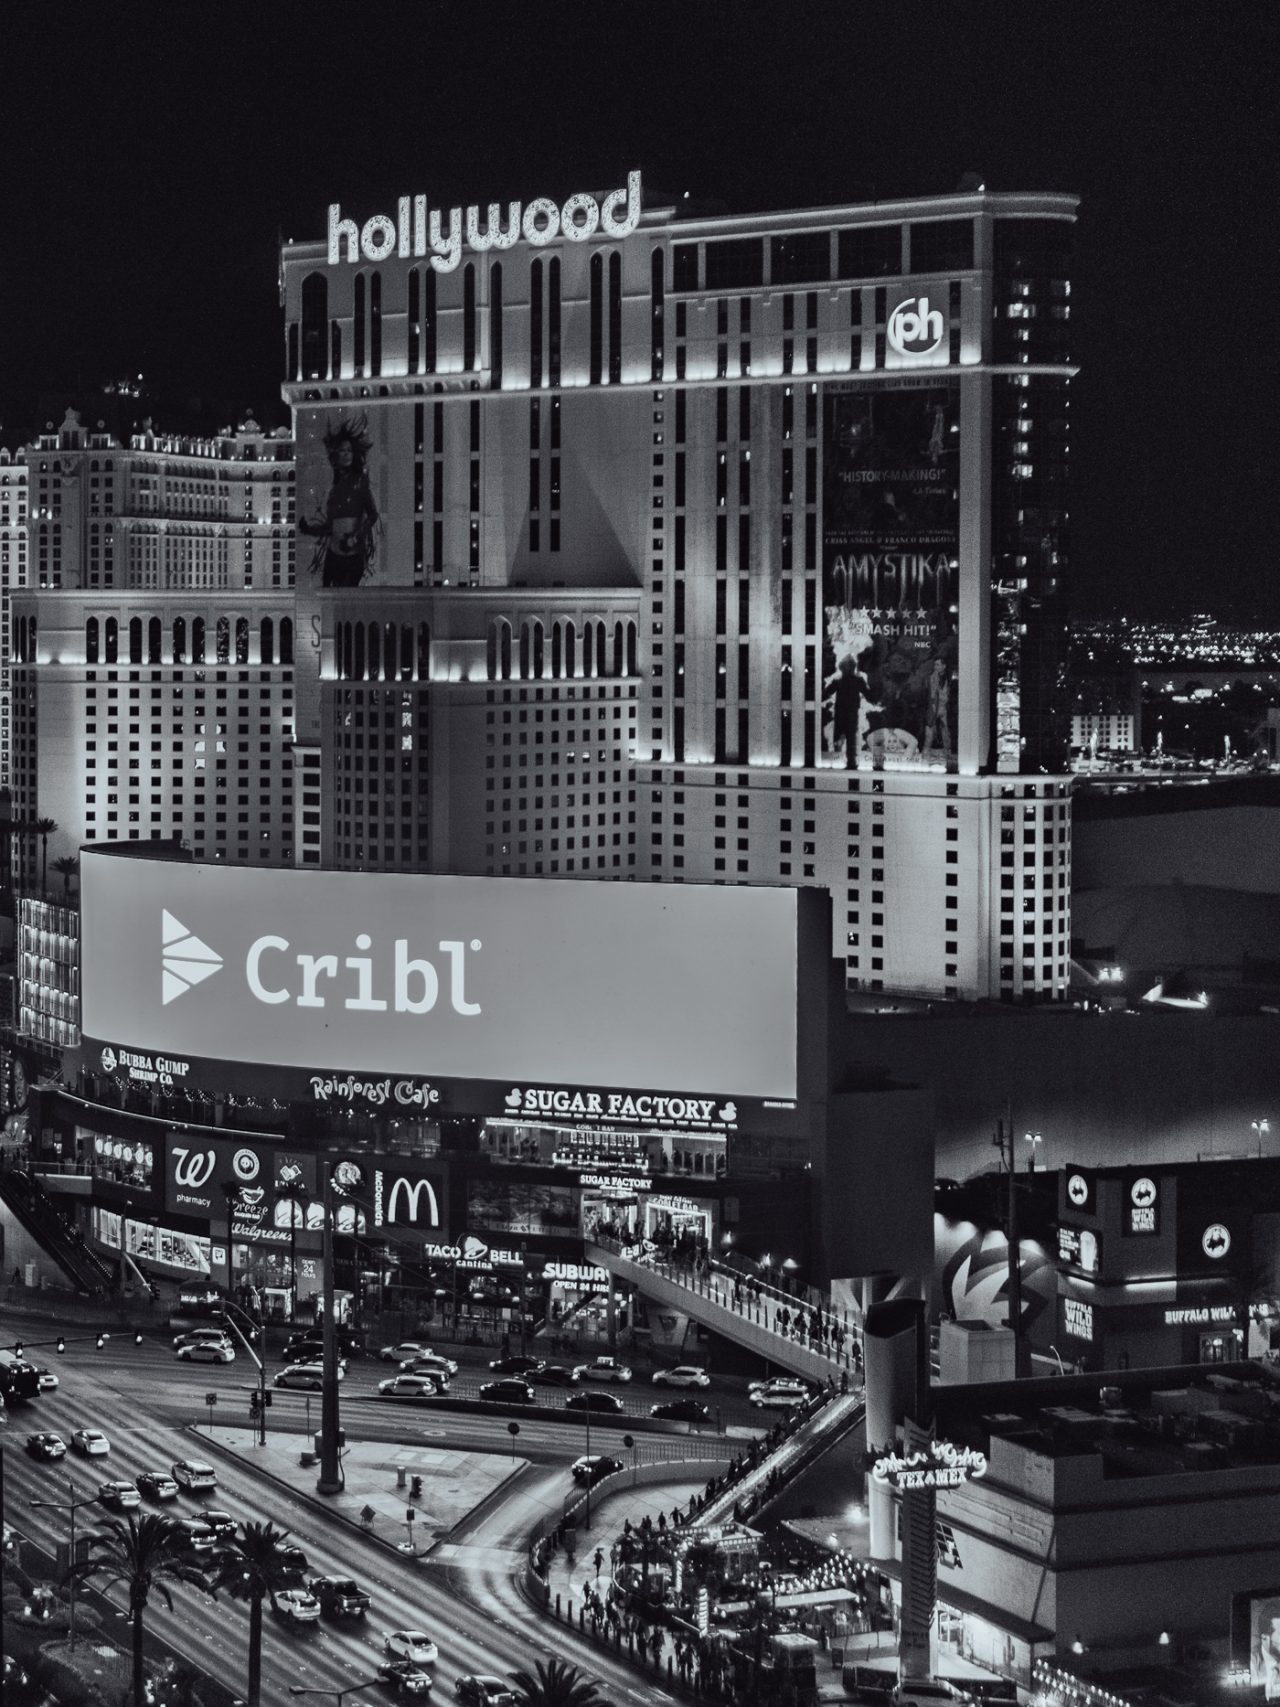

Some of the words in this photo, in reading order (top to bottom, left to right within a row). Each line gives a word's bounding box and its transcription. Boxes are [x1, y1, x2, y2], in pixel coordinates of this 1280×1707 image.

[327, 170, 642, 272] hollywood
[832, 553, 951, 583] AMYSTIKA
[245, 933, 482, 1017] Cribl
[119, 1050, 153, 1070] BUBBA
[156, 1057, 189, 1076] GUMP
[129, 1067, 158, 1083] SHRIMP
[310, 1075, 392, 1105] Rainforest
[394, 1080, 440, 1109] Cafe
[525, 1089, 603, 1114] SUGAR
[608, 1094, 716, 1120] FACTORY
[580, 1174, 611, 1186] SUGAR
[611, 1177, 652, 1189] FACTORY
[176, 1194, 211, 1207] pharmacy
[374, 1170, 384, 1227] McDonald's
[1132, 1213, 1155, 1223] WILD
[232, 1222, 292, 1241] Walgreens
[425, 1243, 462, 1259] TACO
[490, 1249, 524, 1266] BELL
[304, 1265, 313, 1274] 24
[456, 1259, 493, 1271] cantina
[553, 1280, 577, 1290] OPEN
[579, 1282, 590, 1291] 24
[1065, 1308, 1093, 1327] WILD
[1165, 1308, 1209, 1324] BUFFALO
[1210, 1306, 1237, 1321] WIL
[1065, 1319, 1093, 1341] WINGS
[896, 1470, 925, 1489] TEX
[934, 1467, 968, 1486] MEX
